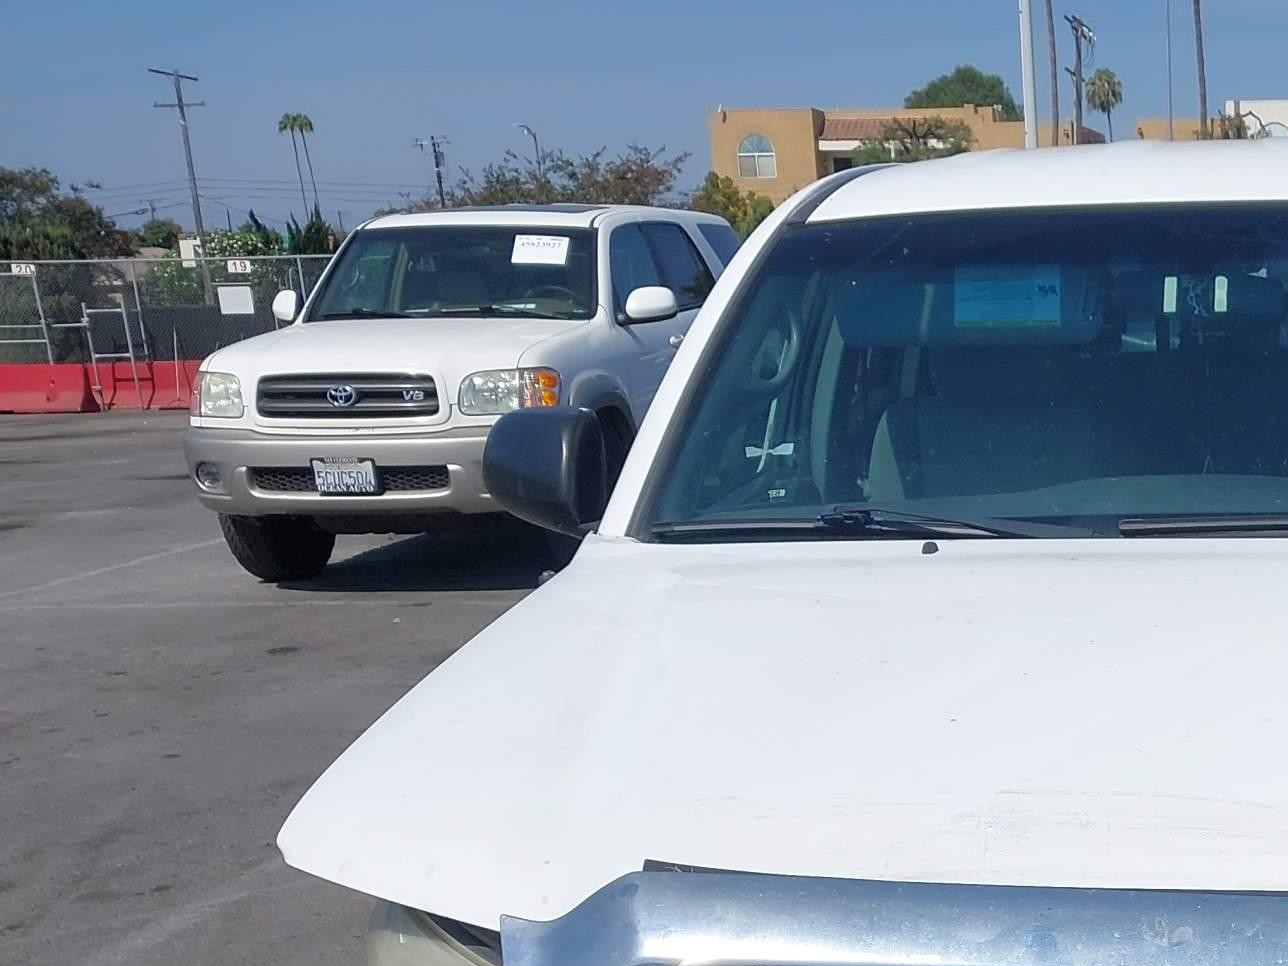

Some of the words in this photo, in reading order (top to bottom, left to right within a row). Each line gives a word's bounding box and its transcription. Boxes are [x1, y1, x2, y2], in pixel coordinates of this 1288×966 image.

[15, 264, 32, 274] 20
[232, 261, 247, 272] 19
[402, 390, 424, 401] V8
[317, 483, 347, 492] OCEAN
[348, 483, 374, 492] AUTO
